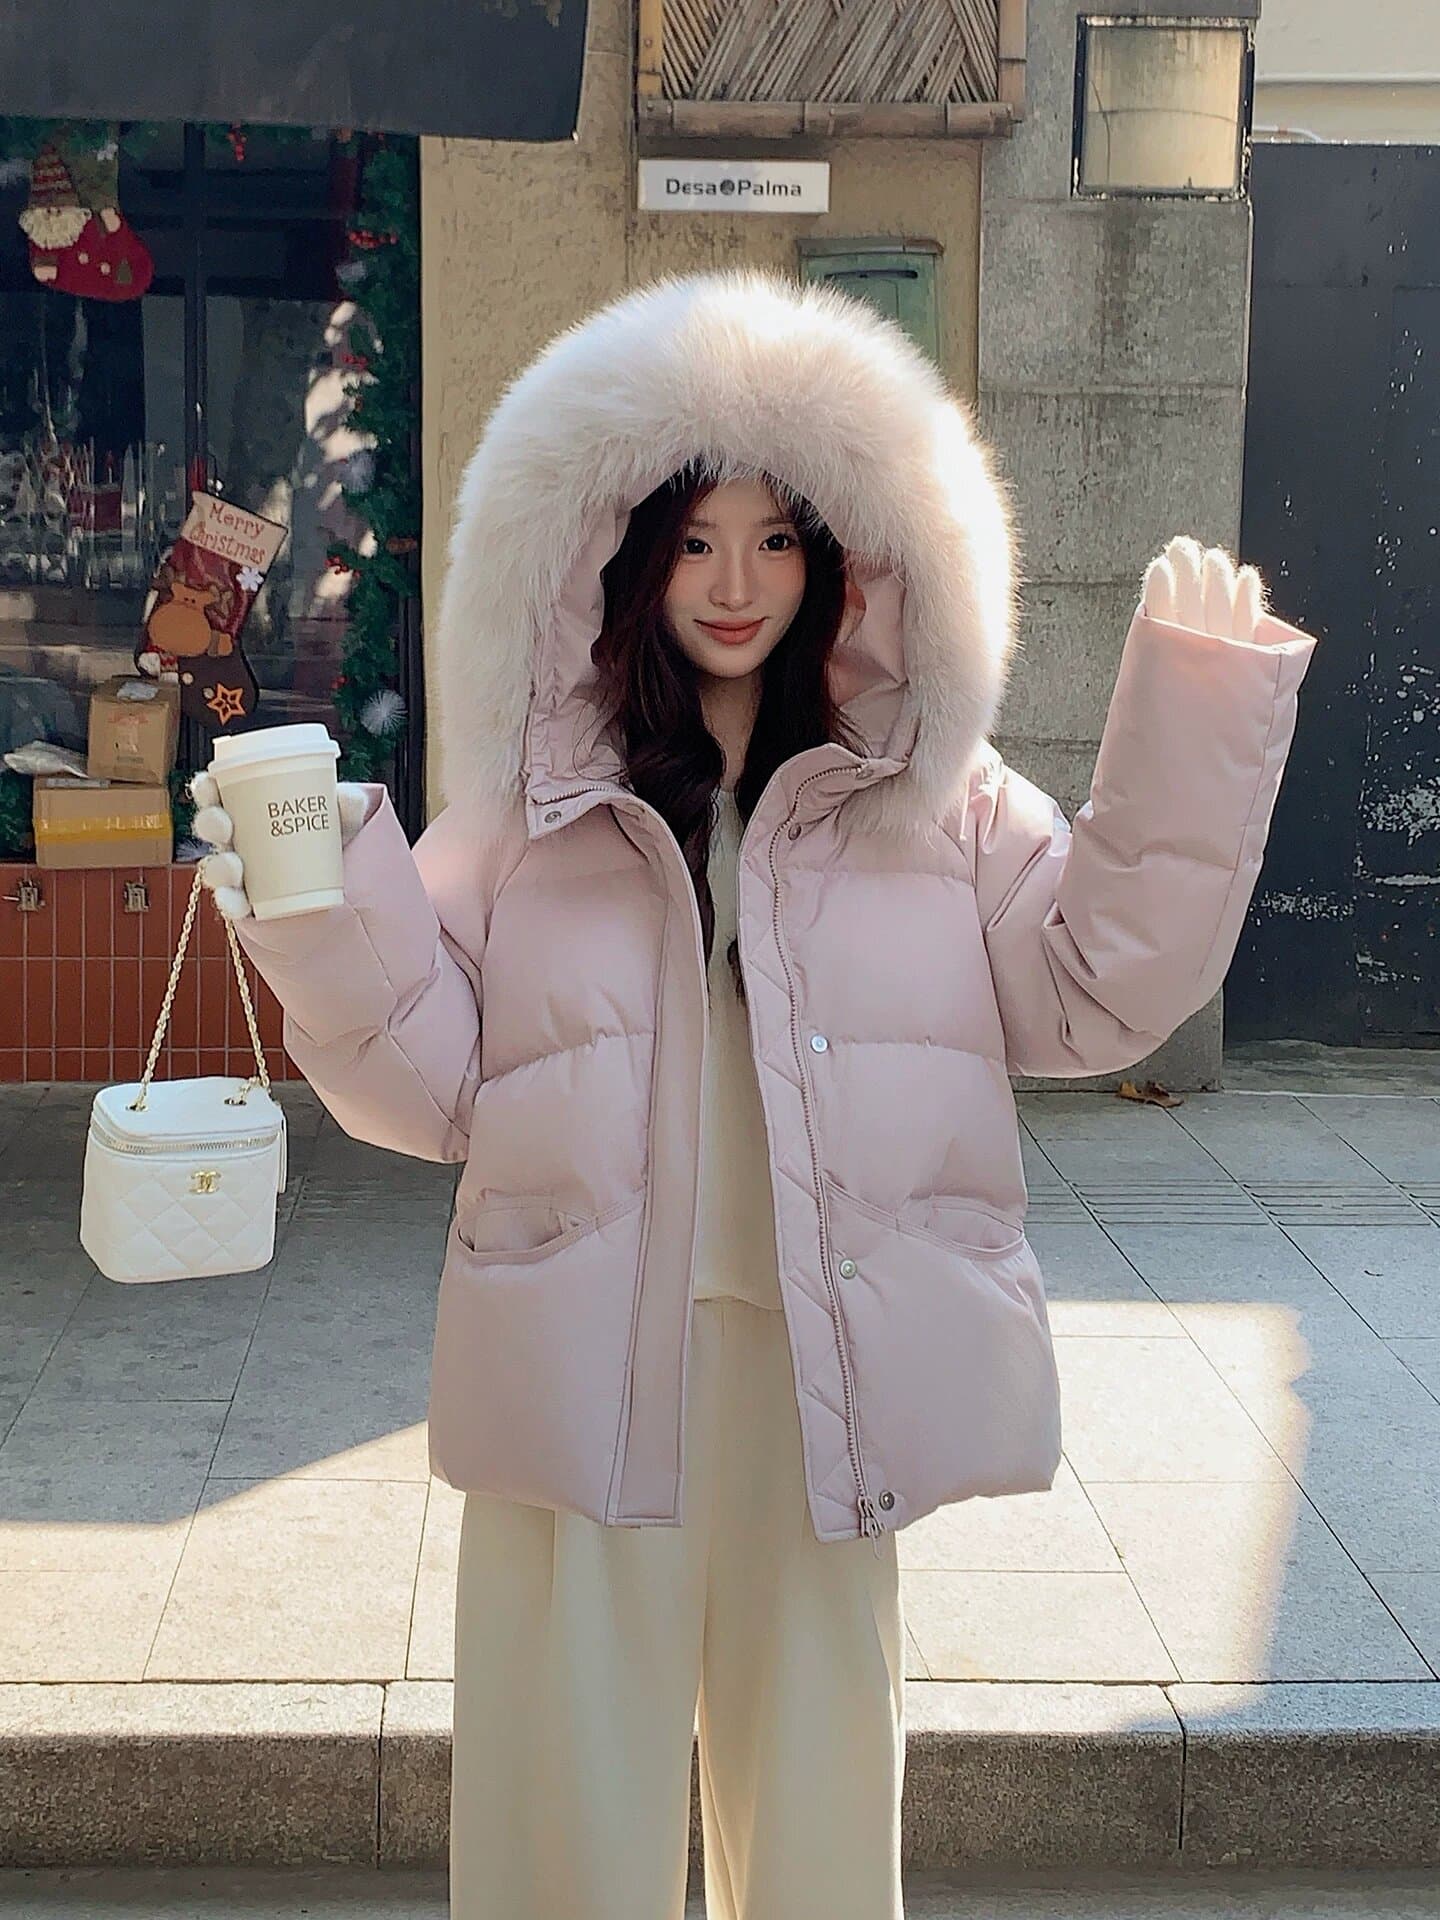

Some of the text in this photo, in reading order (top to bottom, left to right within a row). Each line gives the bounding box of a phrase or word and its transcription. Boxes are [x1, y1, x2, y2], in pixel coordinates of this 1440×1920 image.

[665, 178, 802, 197] Desa Palma
[209, 502, 265, 540] Merry
[267, 795, 328, 818] BAKER
[271, 813, 330, 837] &SPICE
